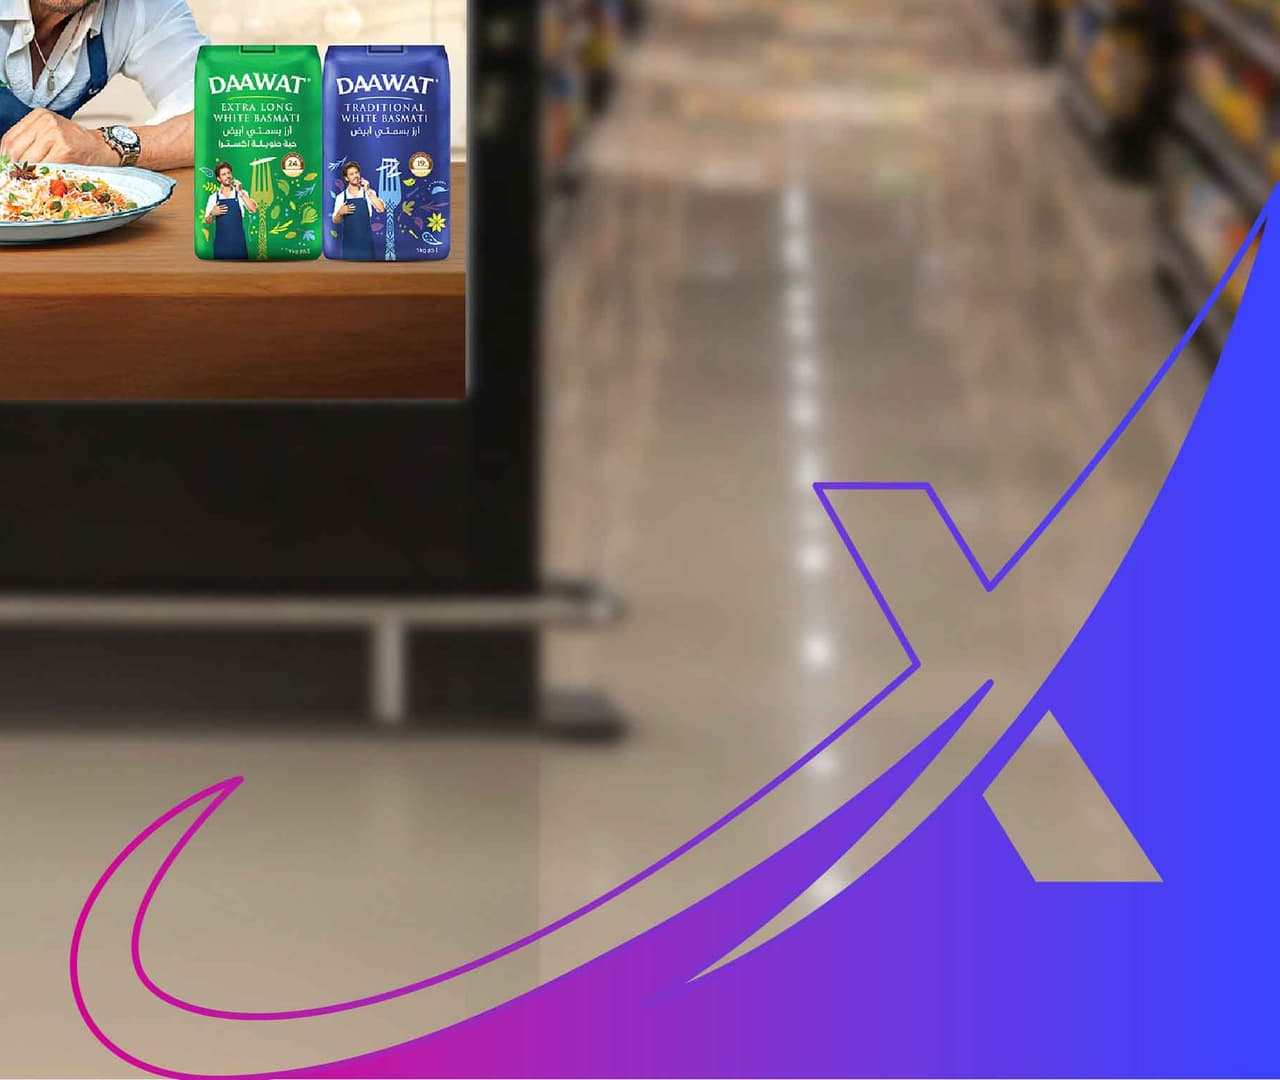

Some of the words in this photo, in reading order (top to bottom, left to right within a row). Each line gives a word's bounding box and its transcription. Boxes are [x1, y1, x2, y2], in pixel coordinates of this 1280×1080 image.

[208, 72, 307, 95] DAAWAT
[336, 73, 435, 95] DAAWAT
[221, 102, 256, 112] EXTRA
[261, 102, 293, 112] LONG
[344, 103, 425, 112] TRADITIONAL
[213, 113, 250, 123] WHITE
[254, 113, 300, 123] BASMATI
[341, 114, 377, 123] WHITE
[382, 114, 428, 123] BASMATI
